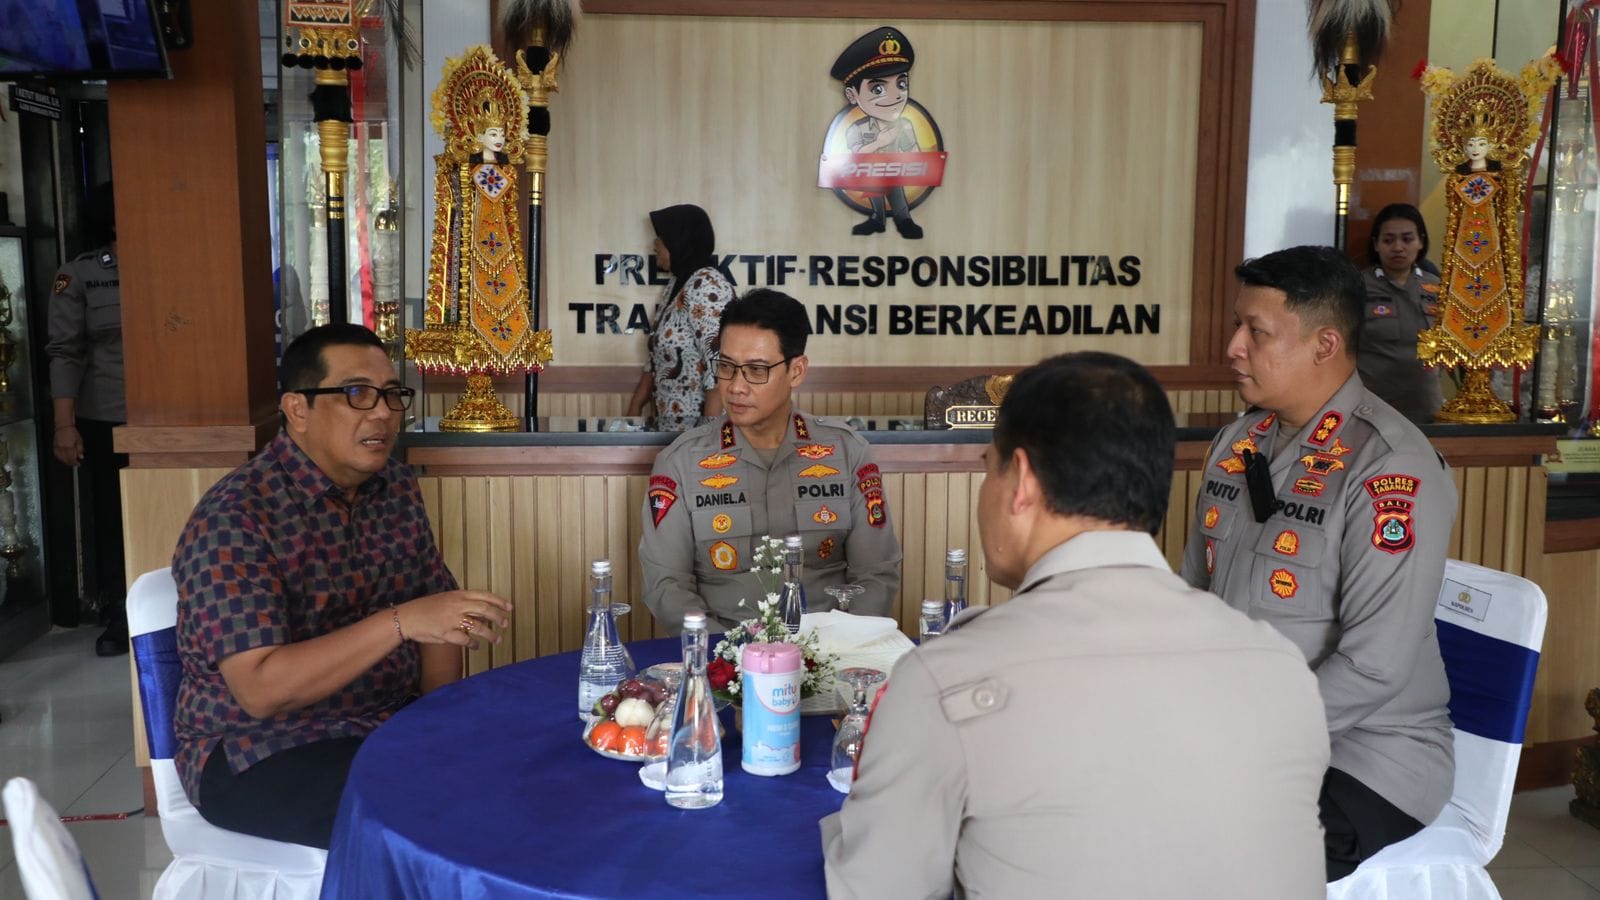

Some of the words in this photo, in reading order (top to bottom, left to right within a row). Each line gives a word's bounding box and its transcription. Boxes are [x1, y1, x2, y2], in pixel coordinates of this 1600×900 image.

[841, 162, 928, 177] PRESISI
[889, 303, 1160, 336] BERKEADILAN
[956, 409, 998, 422] RECE
[1373, 477, 1414, 488] POLRES
[798, 484, 844, 498] POLRI
[1206, 480, 1240, 501] PUTU
[696, 492, 746, 508] DANIEL.A
[1379, 500, 1407, 508] BALI
[1277, 500, 1325, 525] POLRI
[772, 683, 797, 697] mitu
